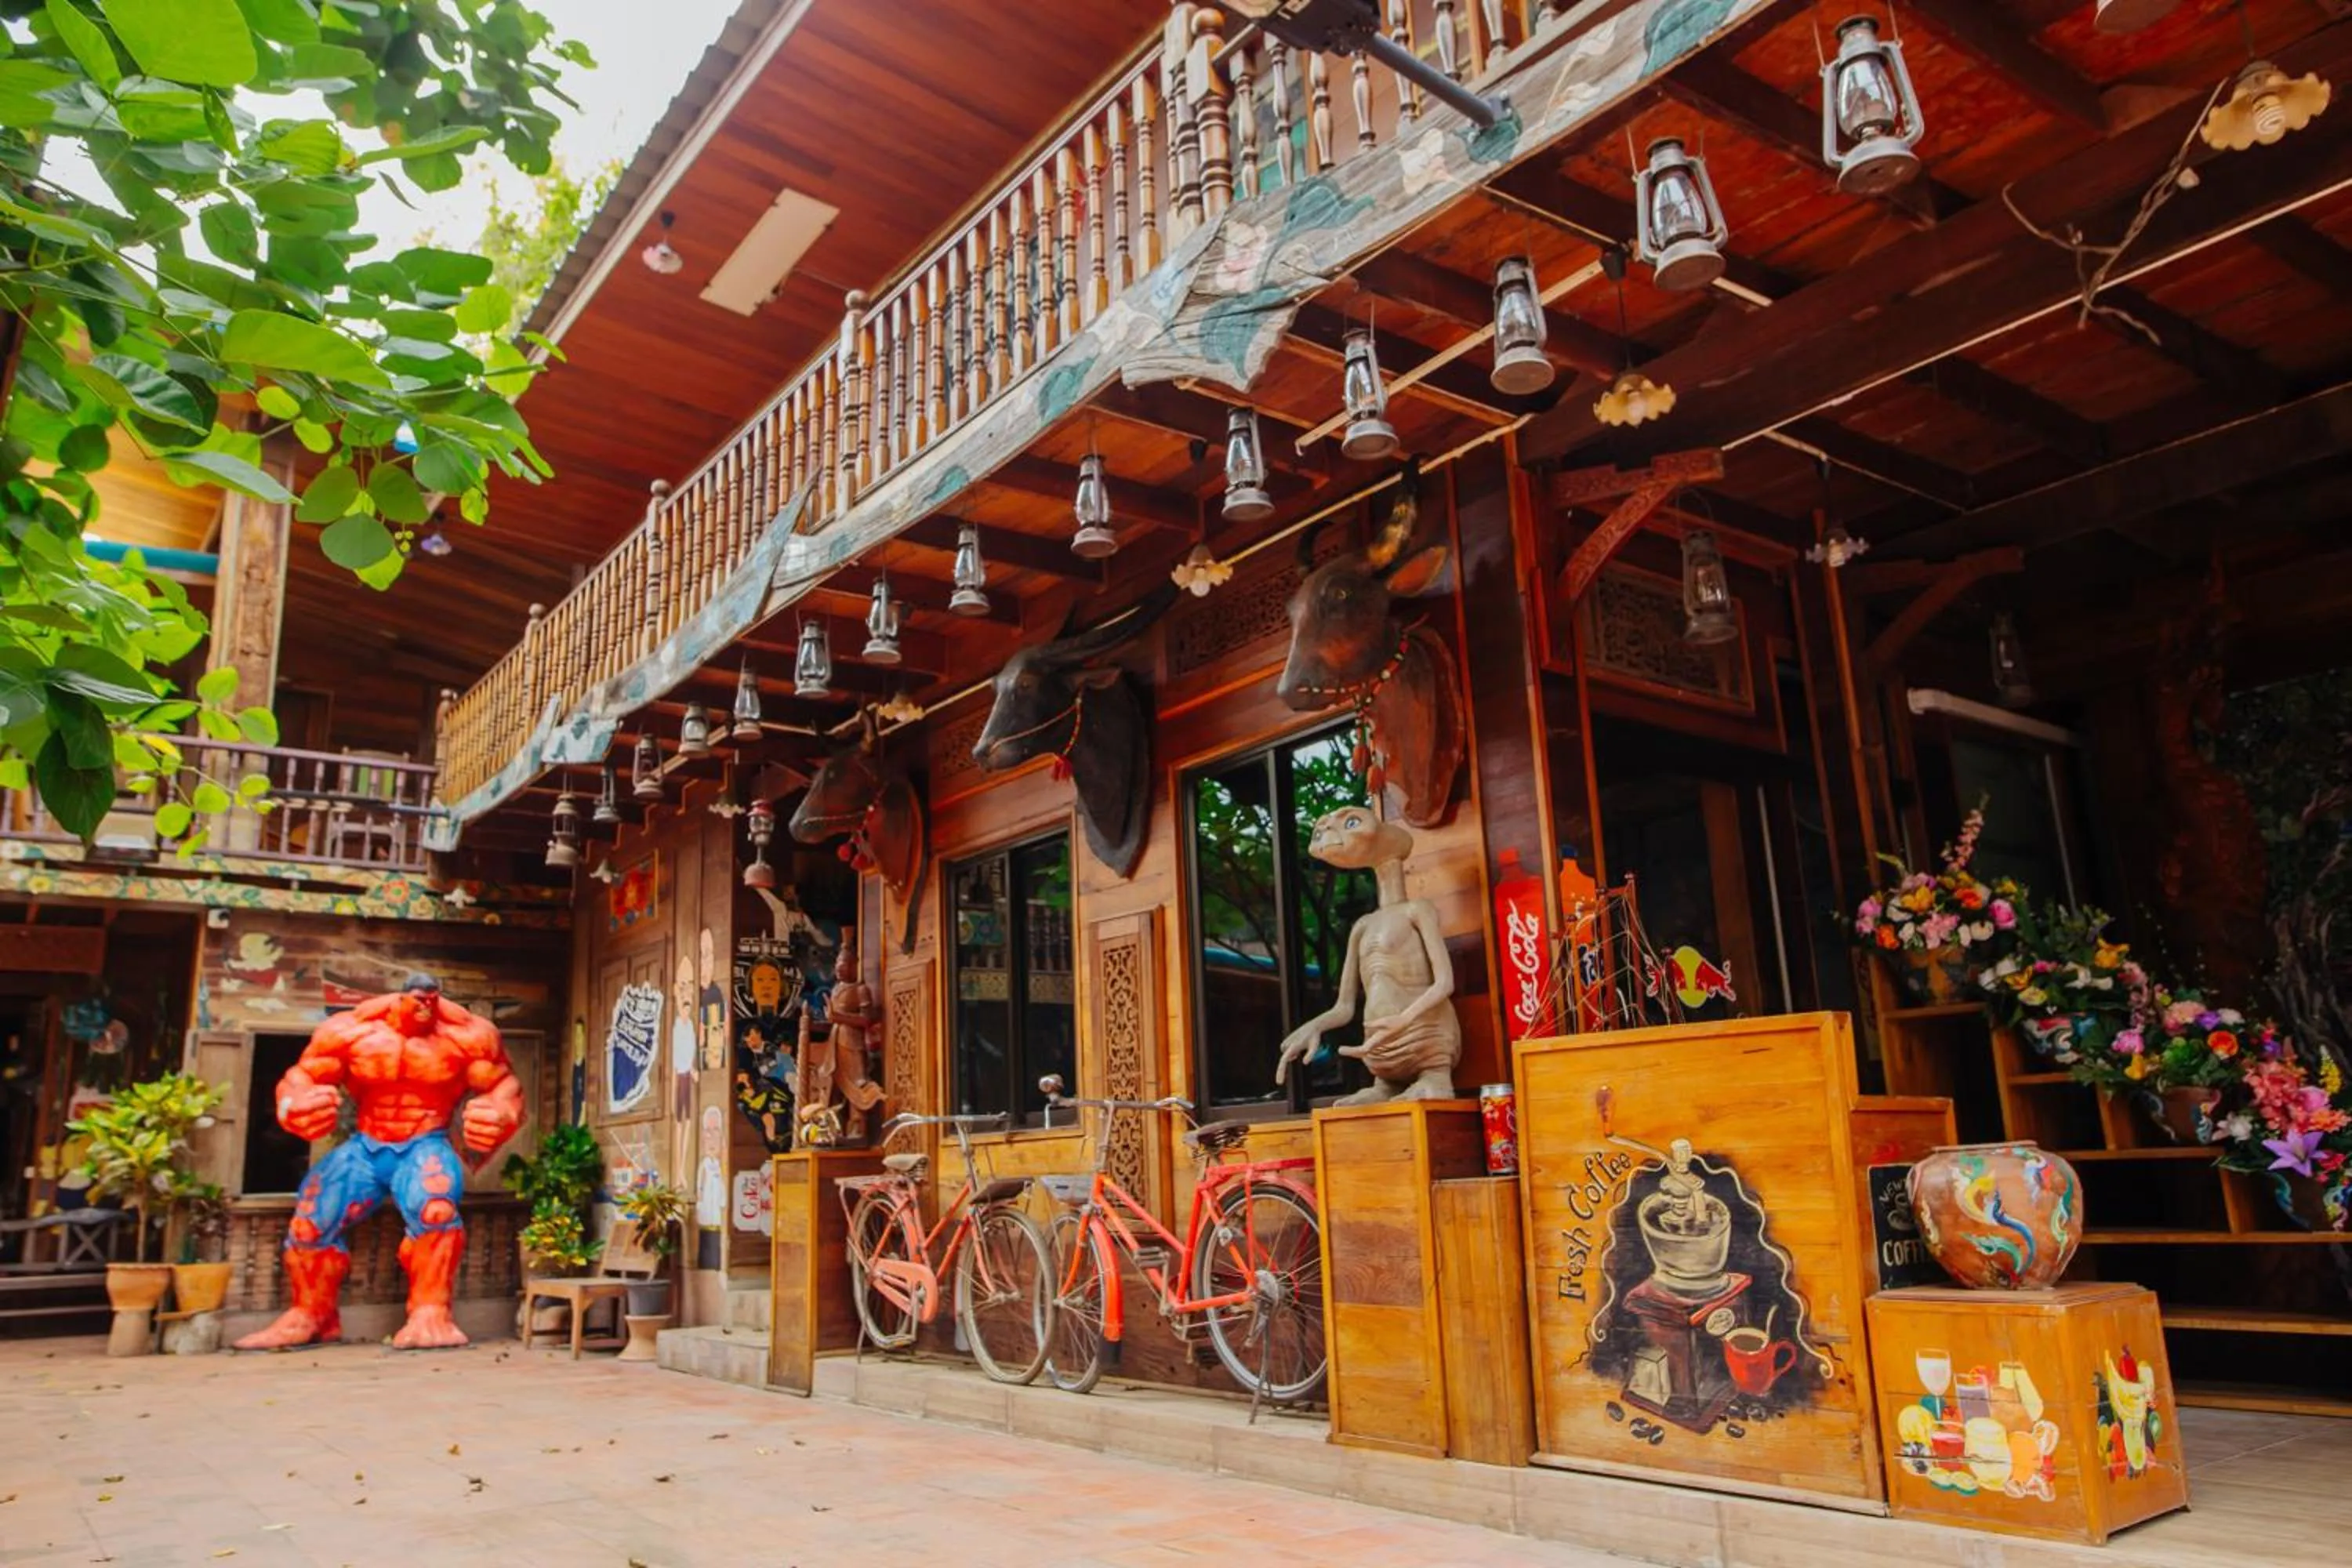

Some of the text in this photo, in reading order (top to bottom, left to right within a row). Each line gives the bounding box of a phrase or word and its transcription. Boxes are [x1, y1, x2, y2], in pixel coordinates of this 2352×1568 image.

[1507, 898, 1540, 1022] Coca-Cola
[1558, 1151, 1632, 1304] Fresh Coffee
